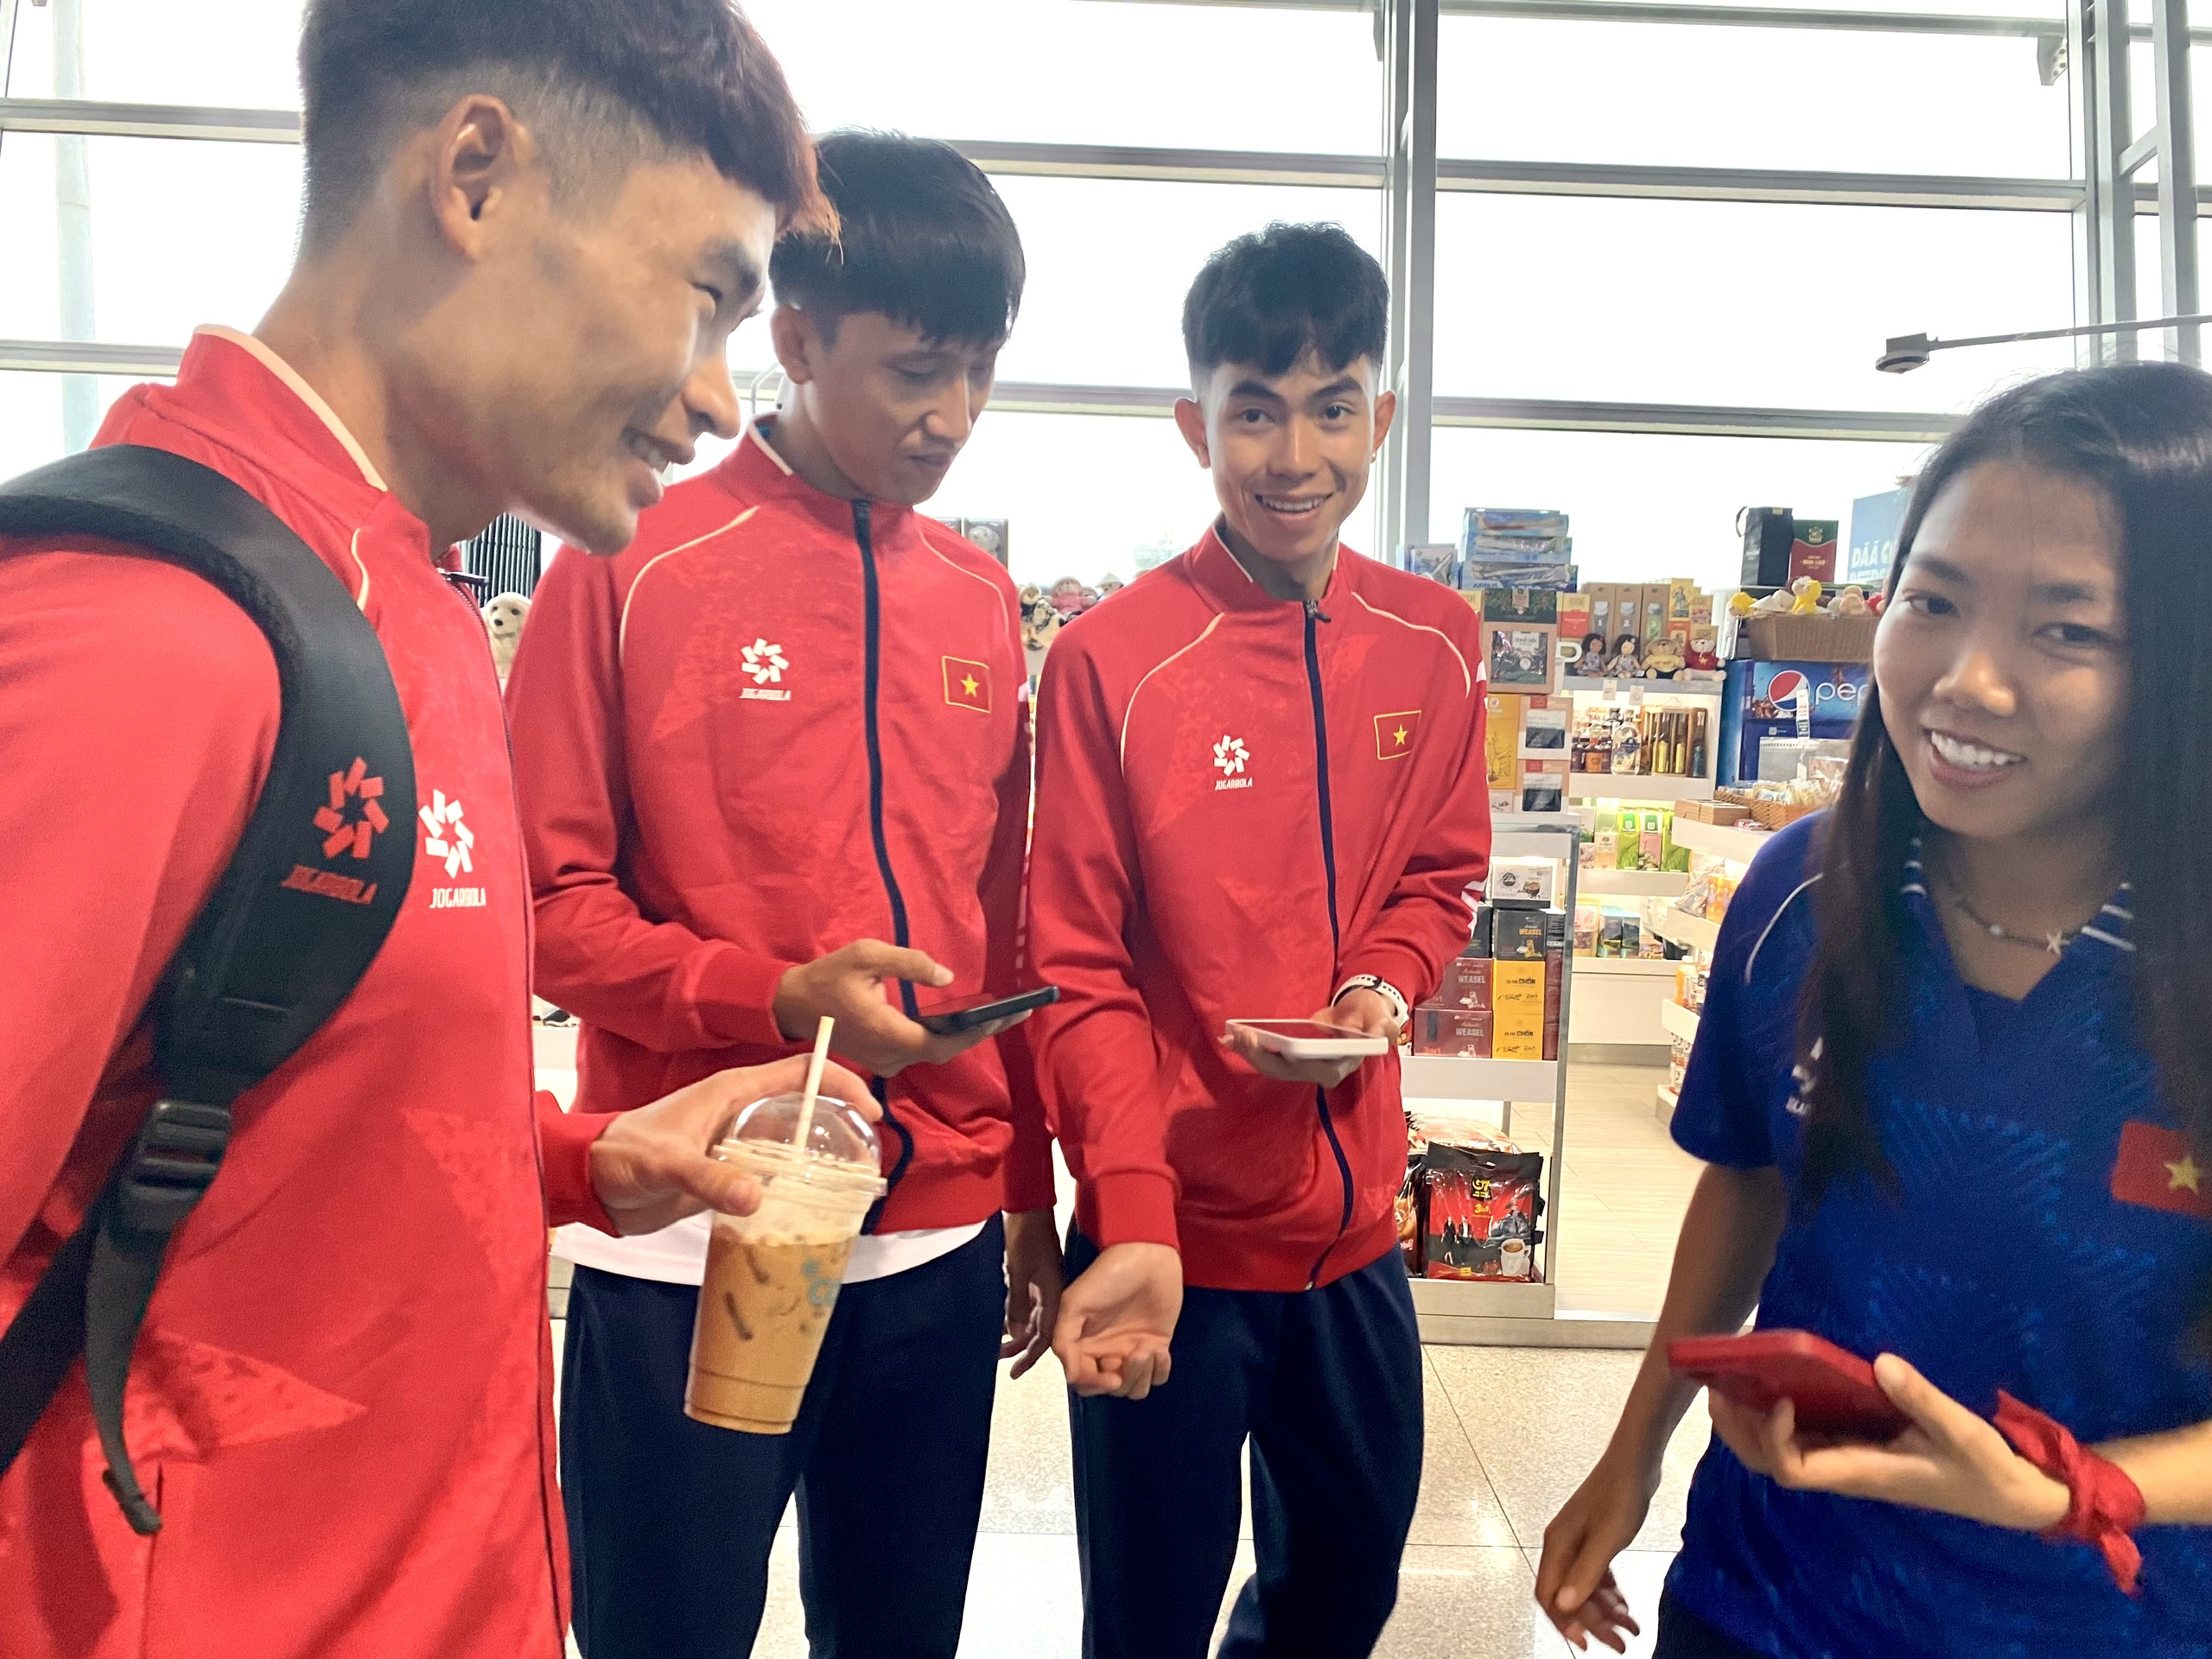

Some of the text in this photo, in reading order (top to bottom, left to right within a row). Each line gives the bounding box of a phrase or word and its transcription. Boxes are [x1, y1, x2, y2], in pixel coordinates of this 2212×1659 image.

[429, 887, 486, 908] JOGARBOLA
[1457, 975, 1486, 984] WEASEL
[1455, 1027, 1484, 1037] WEASEL
[1471, 1179, 1491, 1192] G7
